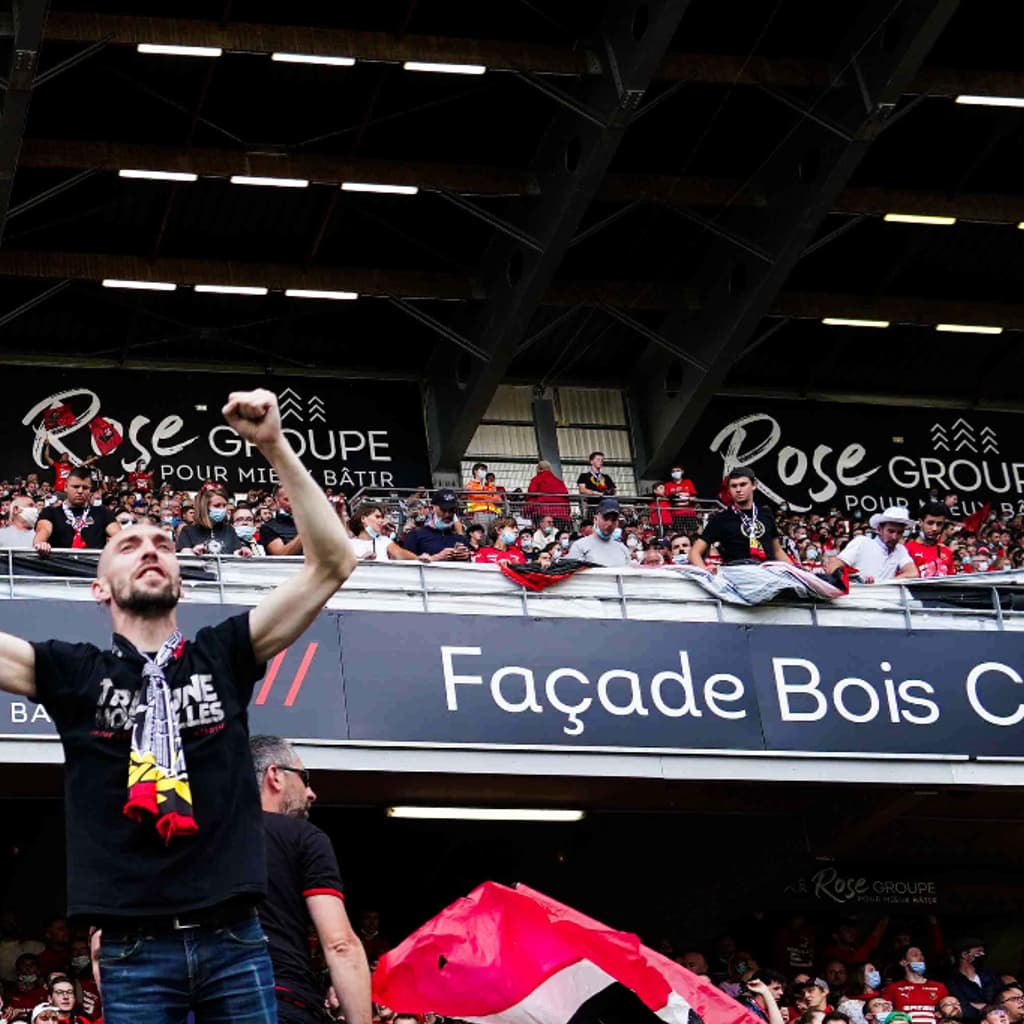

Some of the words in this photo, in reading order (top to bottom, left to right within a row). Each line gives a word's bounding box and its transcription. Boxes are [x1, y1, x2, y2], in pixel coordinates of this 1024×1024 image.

[161, 464, 229, 483] POUR
[324, 467, 394, 488] BÂTIR
[710, 413, 882, 512] Rose
[440, 646, 746, 736] Façade
[772, 657, 940, 724] Bois
